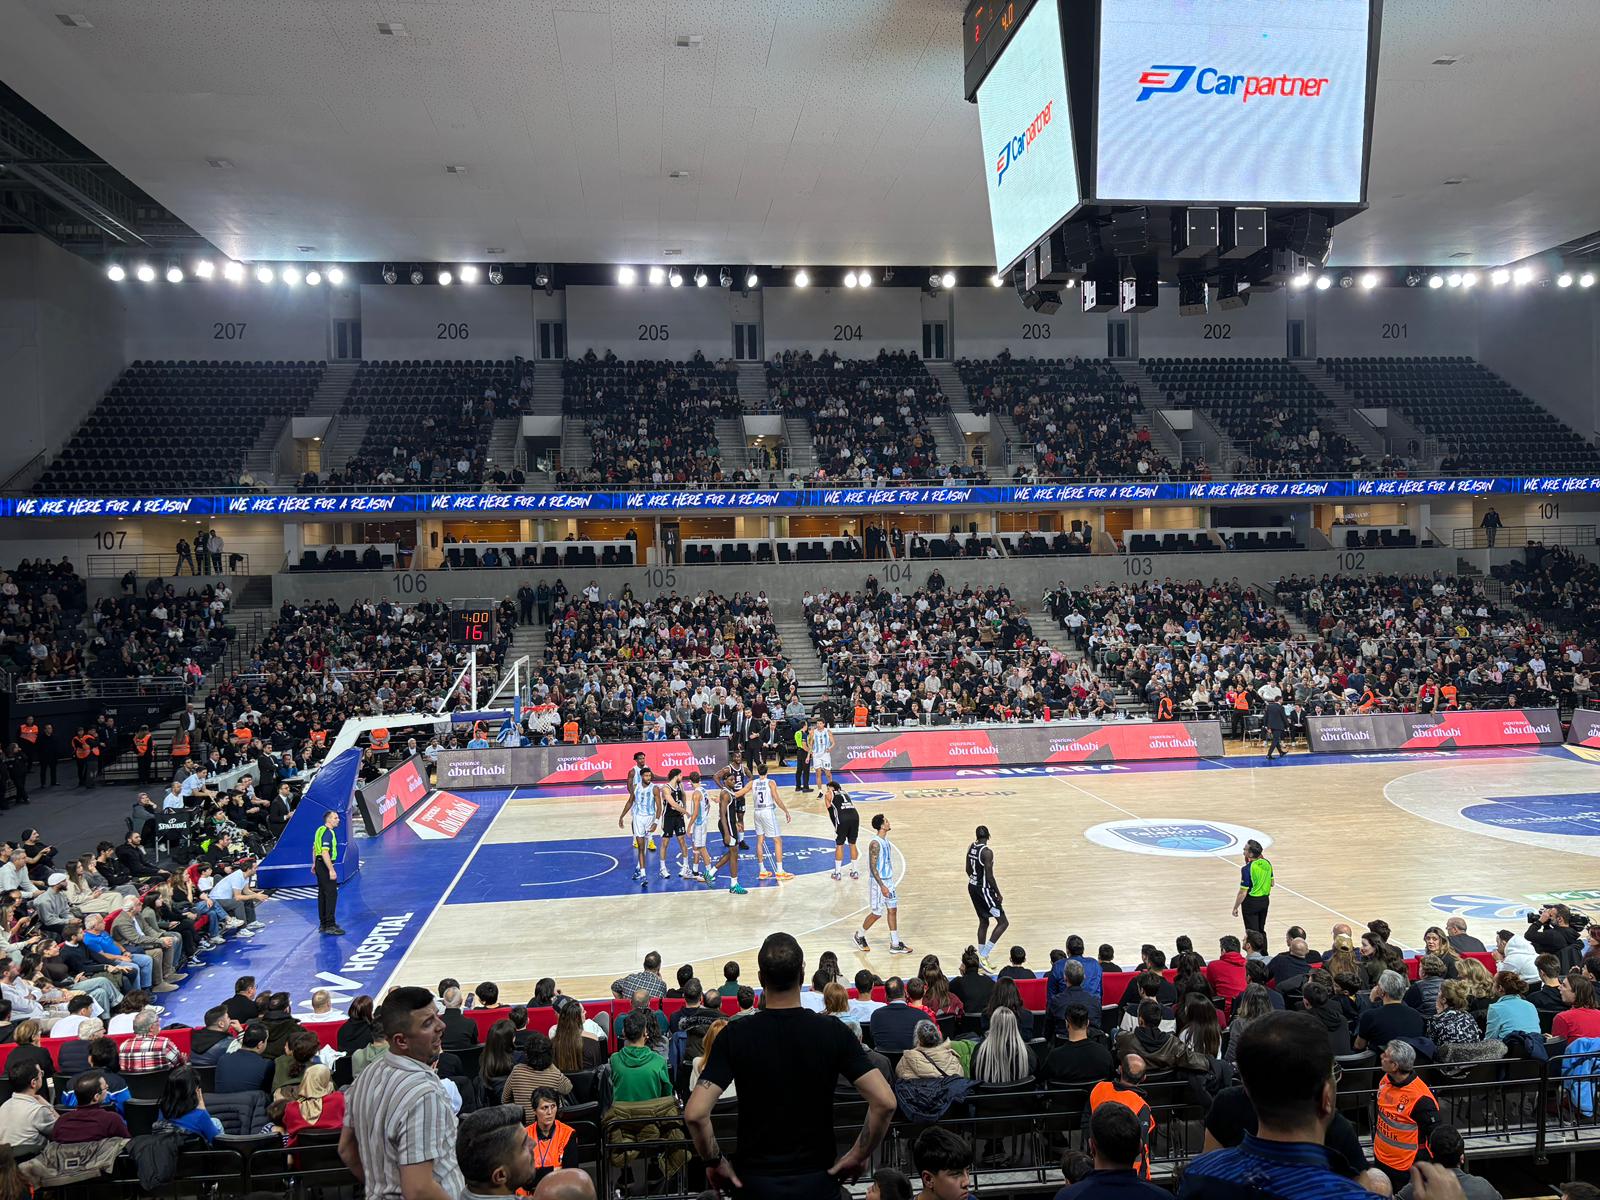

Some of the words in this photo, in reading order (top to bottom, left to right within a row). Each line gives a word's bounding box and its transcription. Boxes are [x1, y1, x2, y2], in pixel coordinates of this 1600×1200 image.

[214, 323, 246, 340] 207
[437, 323, 470, 340] 206
[638, 324, 669, 341] 205
[833, 324, 863, 340] 204
[1022, 323, 1051, 340] 203
[1203, 323, 1231, 340] 202
[1382, 323, 1408, 339] 201
[1190, 484, 1206, 496] WE
[1208, 484, 1228, 496] ARE
[1230, 483, 1259, 497] HERE
[1260, 484, 1279, 495] FOR
[1281, 484, 1288, 494] A
[1290, 482, 1328, 495] REASON
[1358, 481, 1374, 493] WE
[1376, 481, 1396, 493] ARE
[1398, 480, 1424, 494] HERE
[1428, 480, 1445, 492] FOR
[1448, 480, 1456, 491] A
[1458, 479, 1495, 491] REASON
[1524, 478, 1538, 490] WE
[1541, 479, 1560, 490] ARE
[1562, 478, 1588, 491] HERE
[1590, 478, 1600, 489] FO
[626, 494, 645, 507] WE
[648, 494, 671, 506] ARE
[672, 492, 703, 507] HERE
[704, 494, 726, 505] FOR
[728, 494, 736, 505] A
[739, 492, 780, 505] REASON
[824, 490, 842, 504] WE
[844, 491, 866, 503] ARE
[867, 489, 897, 504] HERE
[899, 490, 919, 502] FOR
[922, 490, 929, 501] A
[931, 489, 972, 502] REASON
[1014, 487, 1032, 500] WE
[1034, 488, 1055, 499] ARE
[1056, 485, 1087, 500] HERE
[1088, 486, 1107, 498] FOR
[1110, 487, 1117, 498] A
[1119, 485, 1158, 498] REASON
[16, 498, 37, 514] WE
[40, 499, 64, 513] ARE
[67, 498, 103, 515] HERE
[105, 499, 129, 513] FOR
[132, 500, 142, 512] A
[144, 498, 192, 513] REASON
[229, 496, 249, 511] WE
[252, 498, 277, 510] ARE
[278, 496, 313, 512] HERE
[314, 498, 337, 510] FOR
[339, 498, 348, 510] A
[350, 496, 396, 510] REASON
[431, 494, 451, 508] WE
[453, 495, 478, 508] ARE
[479, 494, 512, 510] HERE
[514, 495, 535, 507] FOR
[538, 495, 546, 507] A
[549, 494, 593, 508] REASON
[1538, 503, 1559, 519] 101
[94, 531, 127, 550] 107
[1123, 558, 1152, 576] 103
[1337, 552, 1365, 570] 102
[644, 569, 676, 588] 105
[882, 564, 912, 582] 104
[393, 574, 427, 593] 106
[462, 613, 489, 623] 4:00
[465, 625, 482, 640] 16
[1321, 732, 1340, 742] abu
[1341, 730, 1370, 740] dhabi
[1413, 729, 1432, 738] abu
[1433, 728, 1461, 737] dhabi
[1504, 726, 1522, 734] abu
[1523, 724, 1551, 734] dhabi
[1588, 728, 1600, 737] ab
[949, 746, 969, 755] abu
[970, 744, 999, 755] dhabi
[1050, 743, 1068, 752] abu
[1070, 742, 1099, 750] dhabi
[1149, 740, 1168, 748] abu
[1169, 738, 1197, 747] dhabi
[661, 757, 683, 767] abu
[684, 755, 716, 766] dhabi
[847, 750, 866, 759] abu
[868, 748, 897, 758] dhabi
[448, 766, 470, 776] abu
[472, 765, 505, 776] dhabi
[556, 761, 578, 772] abu
[580, 760, 612, 770] dhabi
[956, 764, 1131, 776] ANKARA
[758, 792, 764, 803] 3
[339, 912, 414, 972] HOSPITAL
